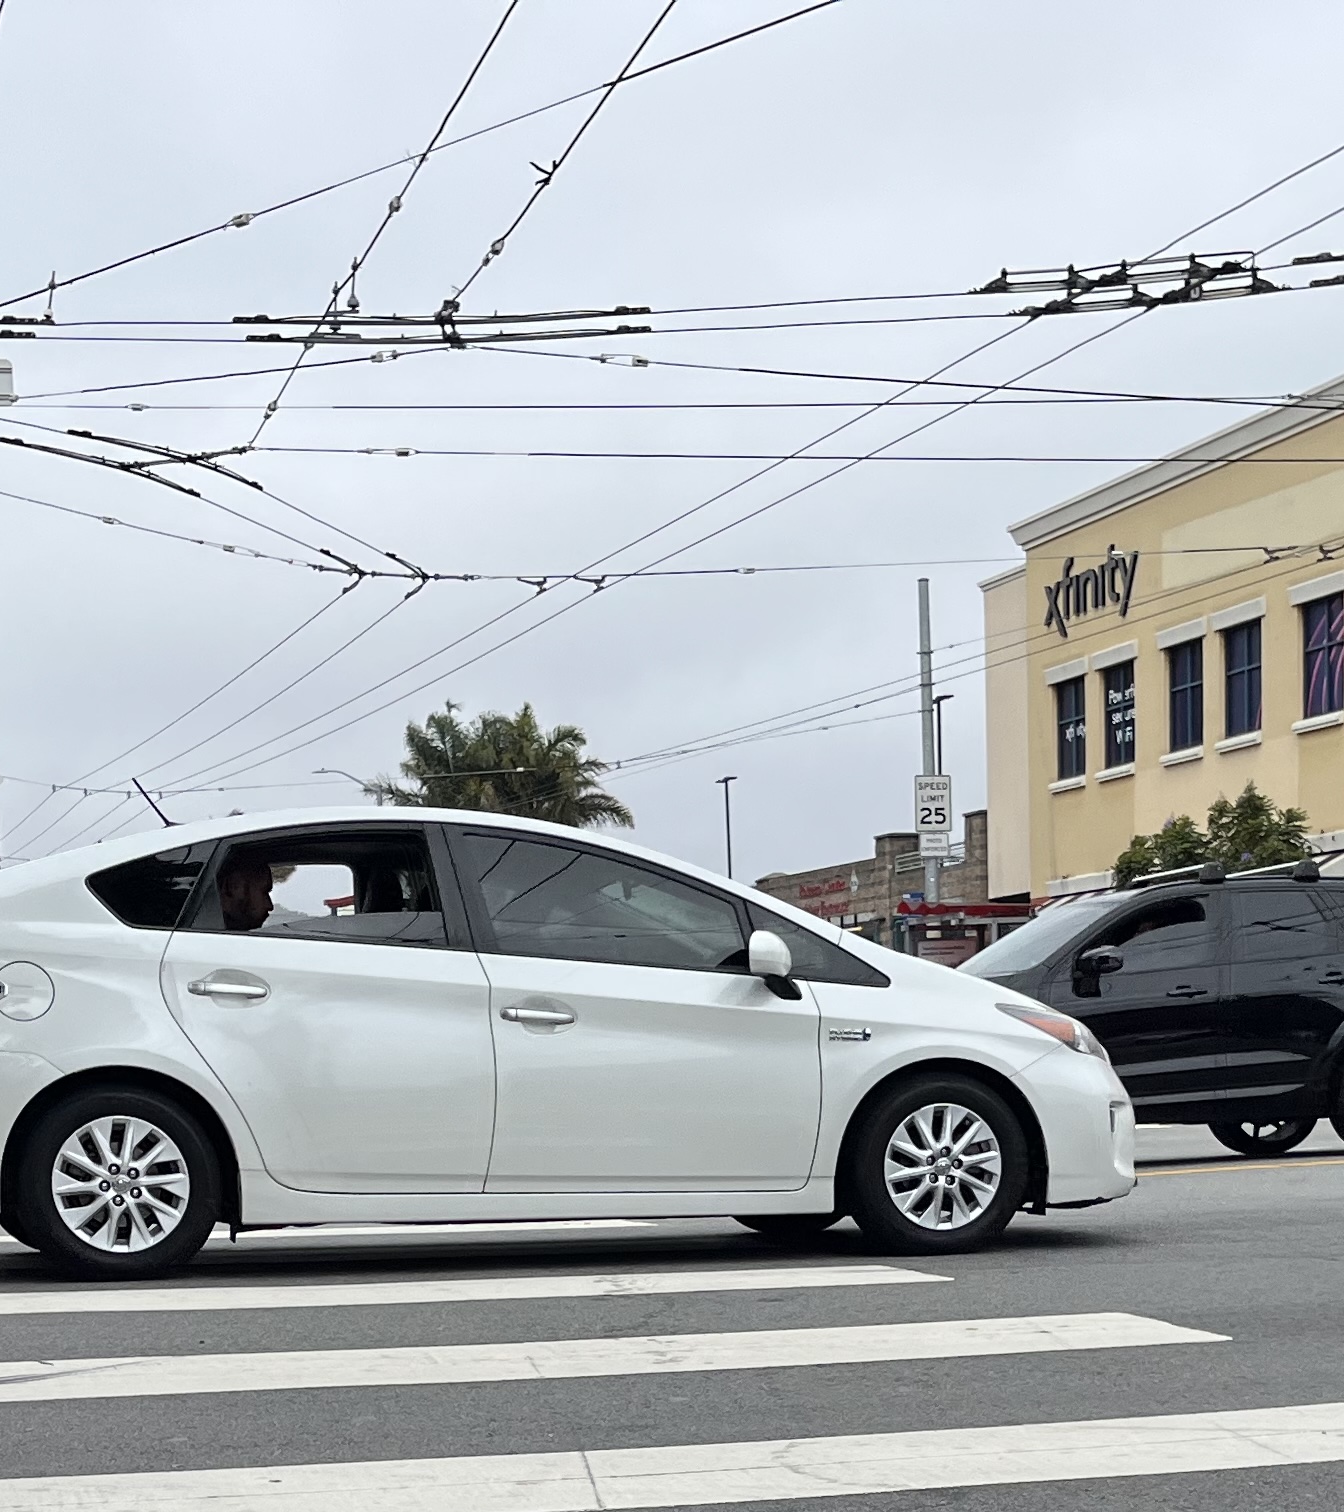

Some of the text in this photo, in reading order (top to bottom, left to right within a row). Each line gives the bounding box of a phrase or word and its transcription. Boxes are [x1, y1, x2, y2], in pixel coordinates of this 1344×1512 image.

[1044, 543, 1139, 639] xfinity
[918, 782, 948, 791] SPEED
[921, 795, 945, 803] LIMIT
[920, 808, 947, 825] 25
